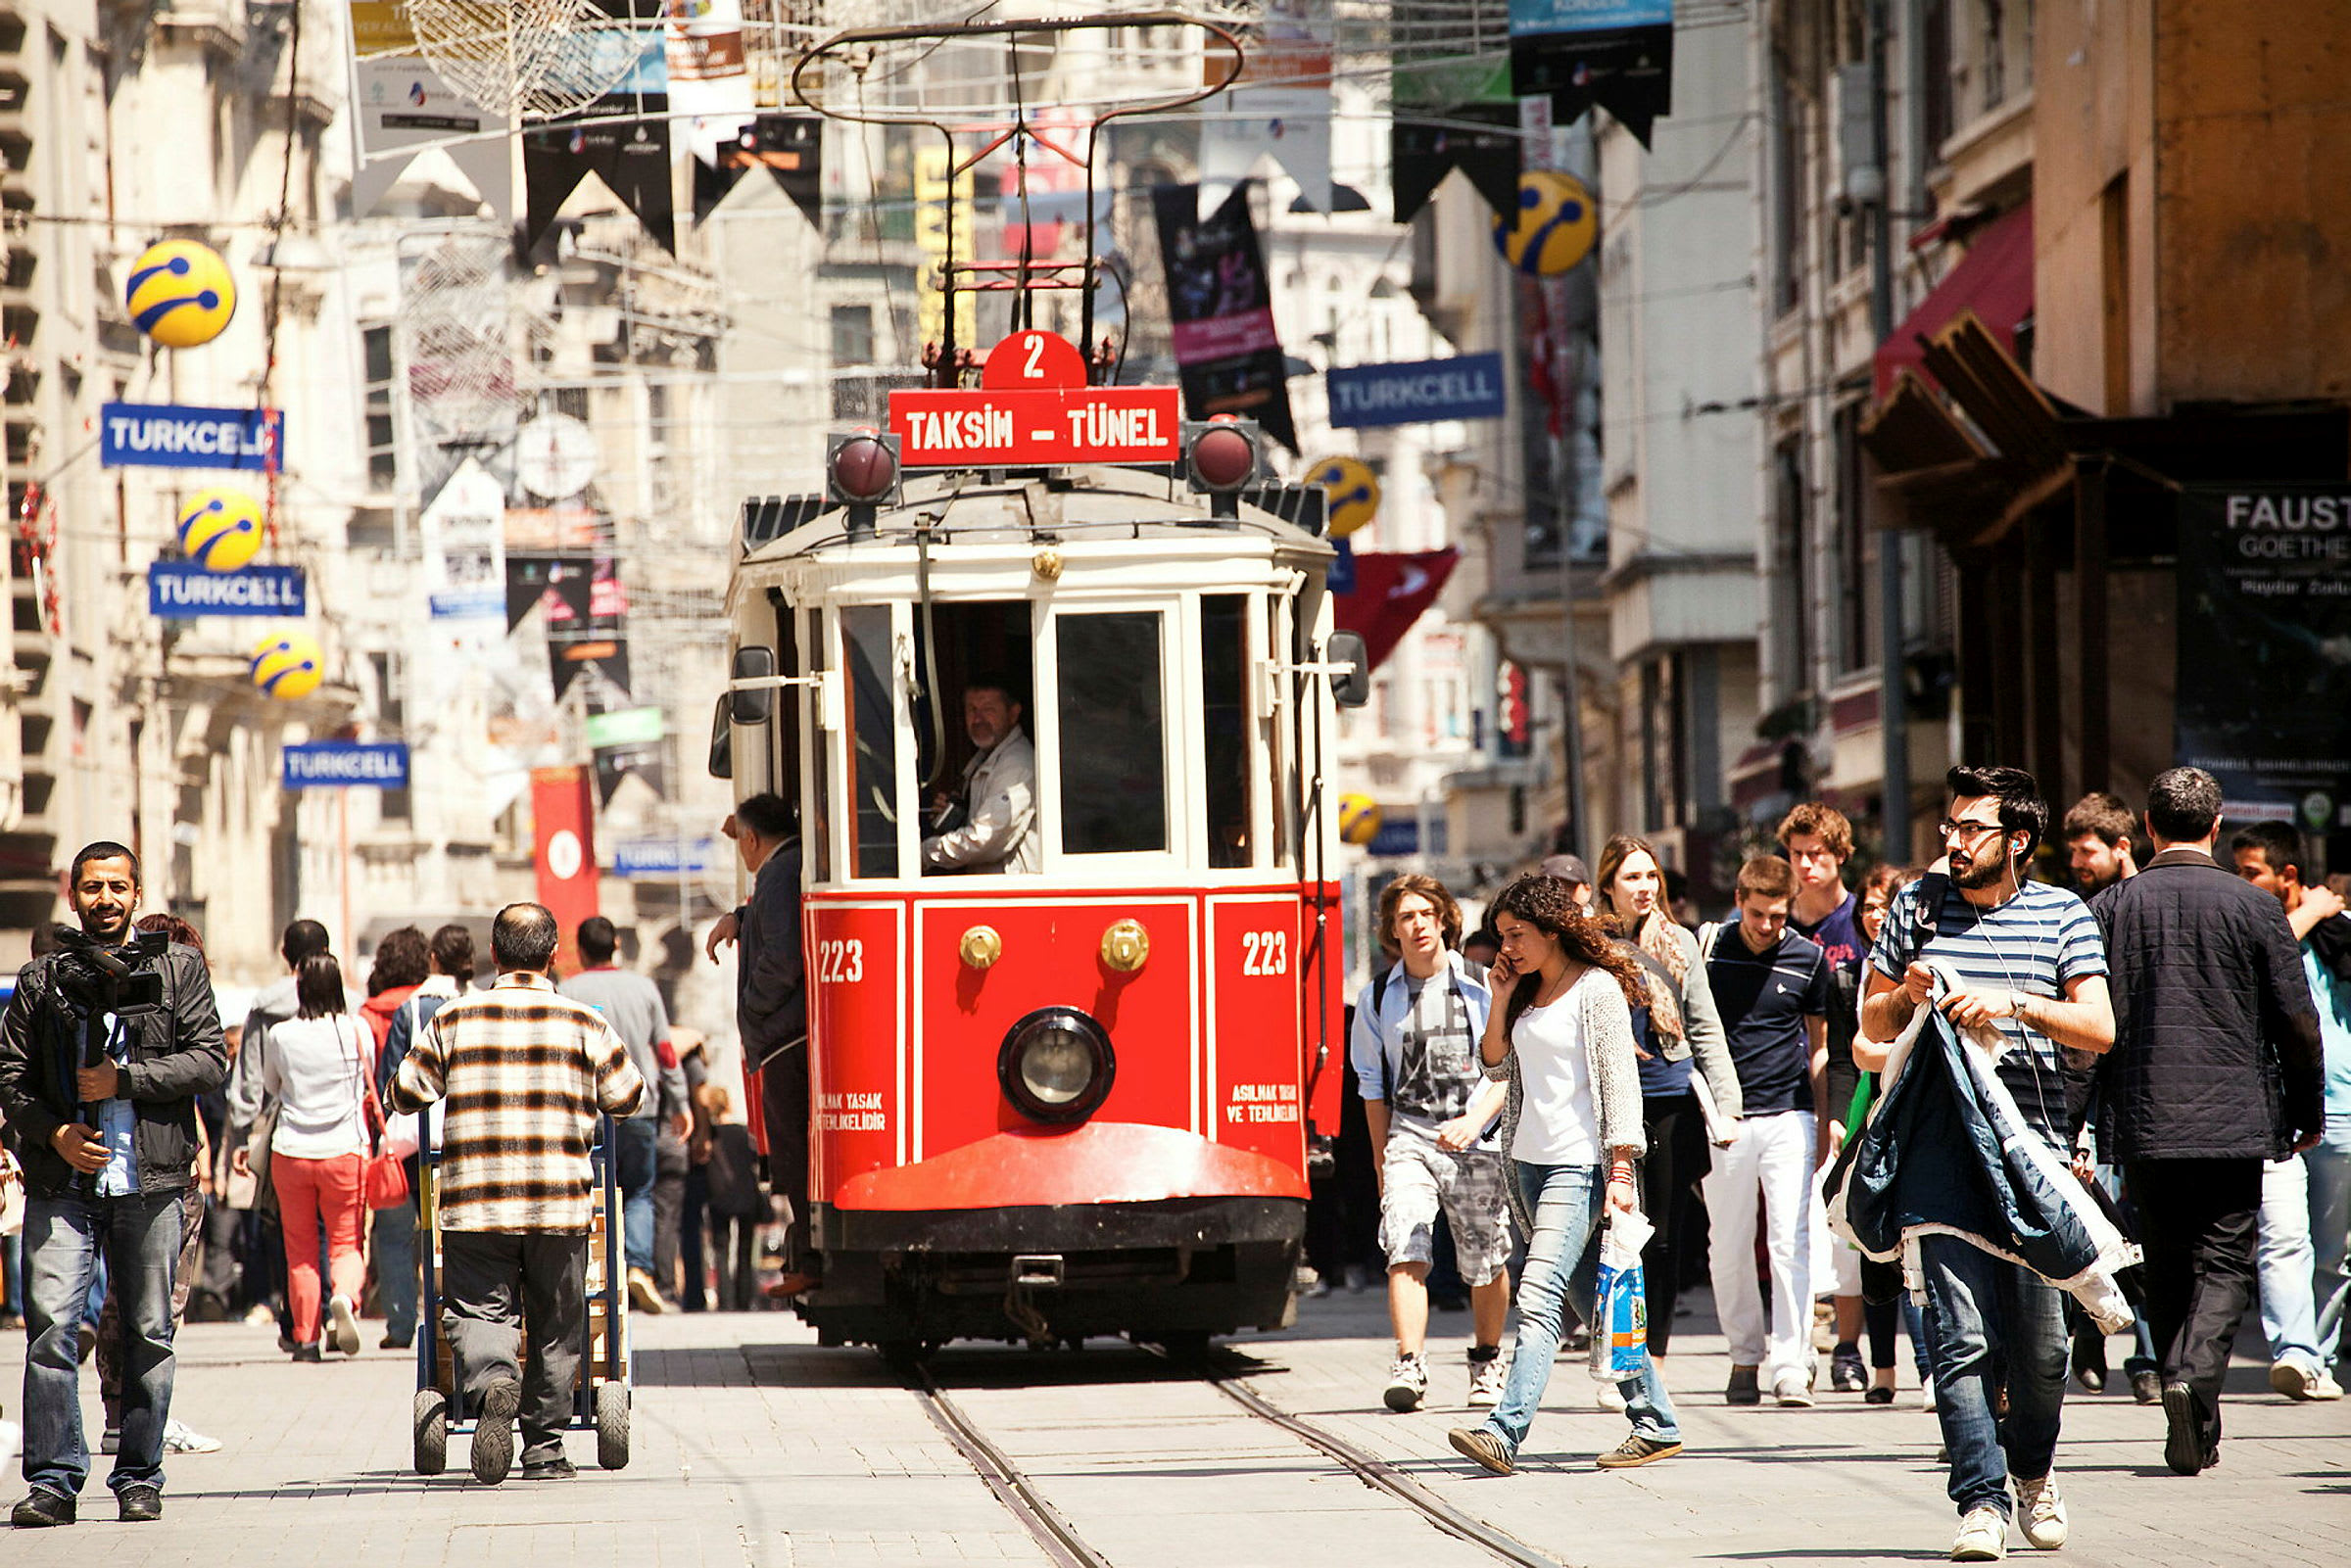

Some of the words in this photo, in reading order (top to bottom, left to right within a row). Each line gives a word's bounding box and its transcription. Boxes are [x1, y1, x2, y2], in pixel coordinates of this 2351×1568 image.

[1024, 335, 1044, 378] 2
[1335, 369, 1494, 411] TURKCELL
[906, 404, 1013, 451] TAKSİM
[1067, 403, 1169, 448] TÜNEL
[2238, 534, 2349, 559] GOETHE
[156, 574, 301, 606] TURKCELL
[288, 750, 404, 779] TURKCELL
[820, 938, 863, 982] 223
[1242, 930, 1287, 975] 223
[845, 1091, 883, 1111] YASAK
[1226, 1104, 1244, 1123] VE
